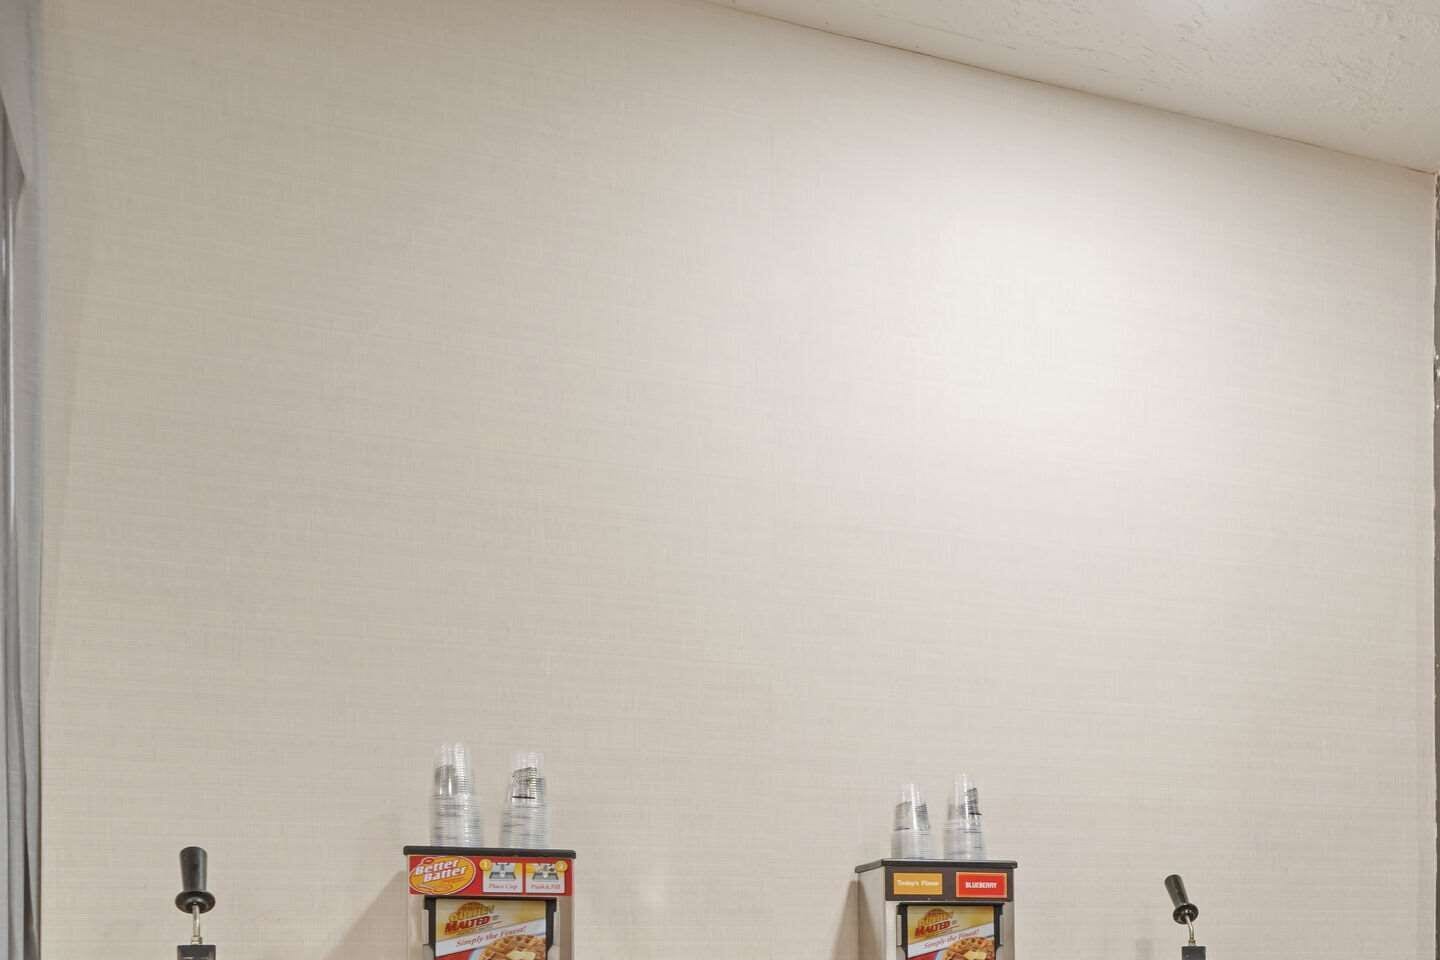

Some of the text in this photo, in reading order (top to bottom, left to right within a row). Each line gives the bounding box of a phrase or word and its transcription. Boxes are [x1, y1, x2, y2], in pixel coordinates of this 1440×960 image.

[415, 859, 459, 876] Better
[423, 867, 466, 883] Batter
[965, 881, 997, 889] BLUEBERRY
[445, 915, 491, 934] MALTED
[914, 920, 950, 937] MALTED
[456, 934, 484, 947] Simply
